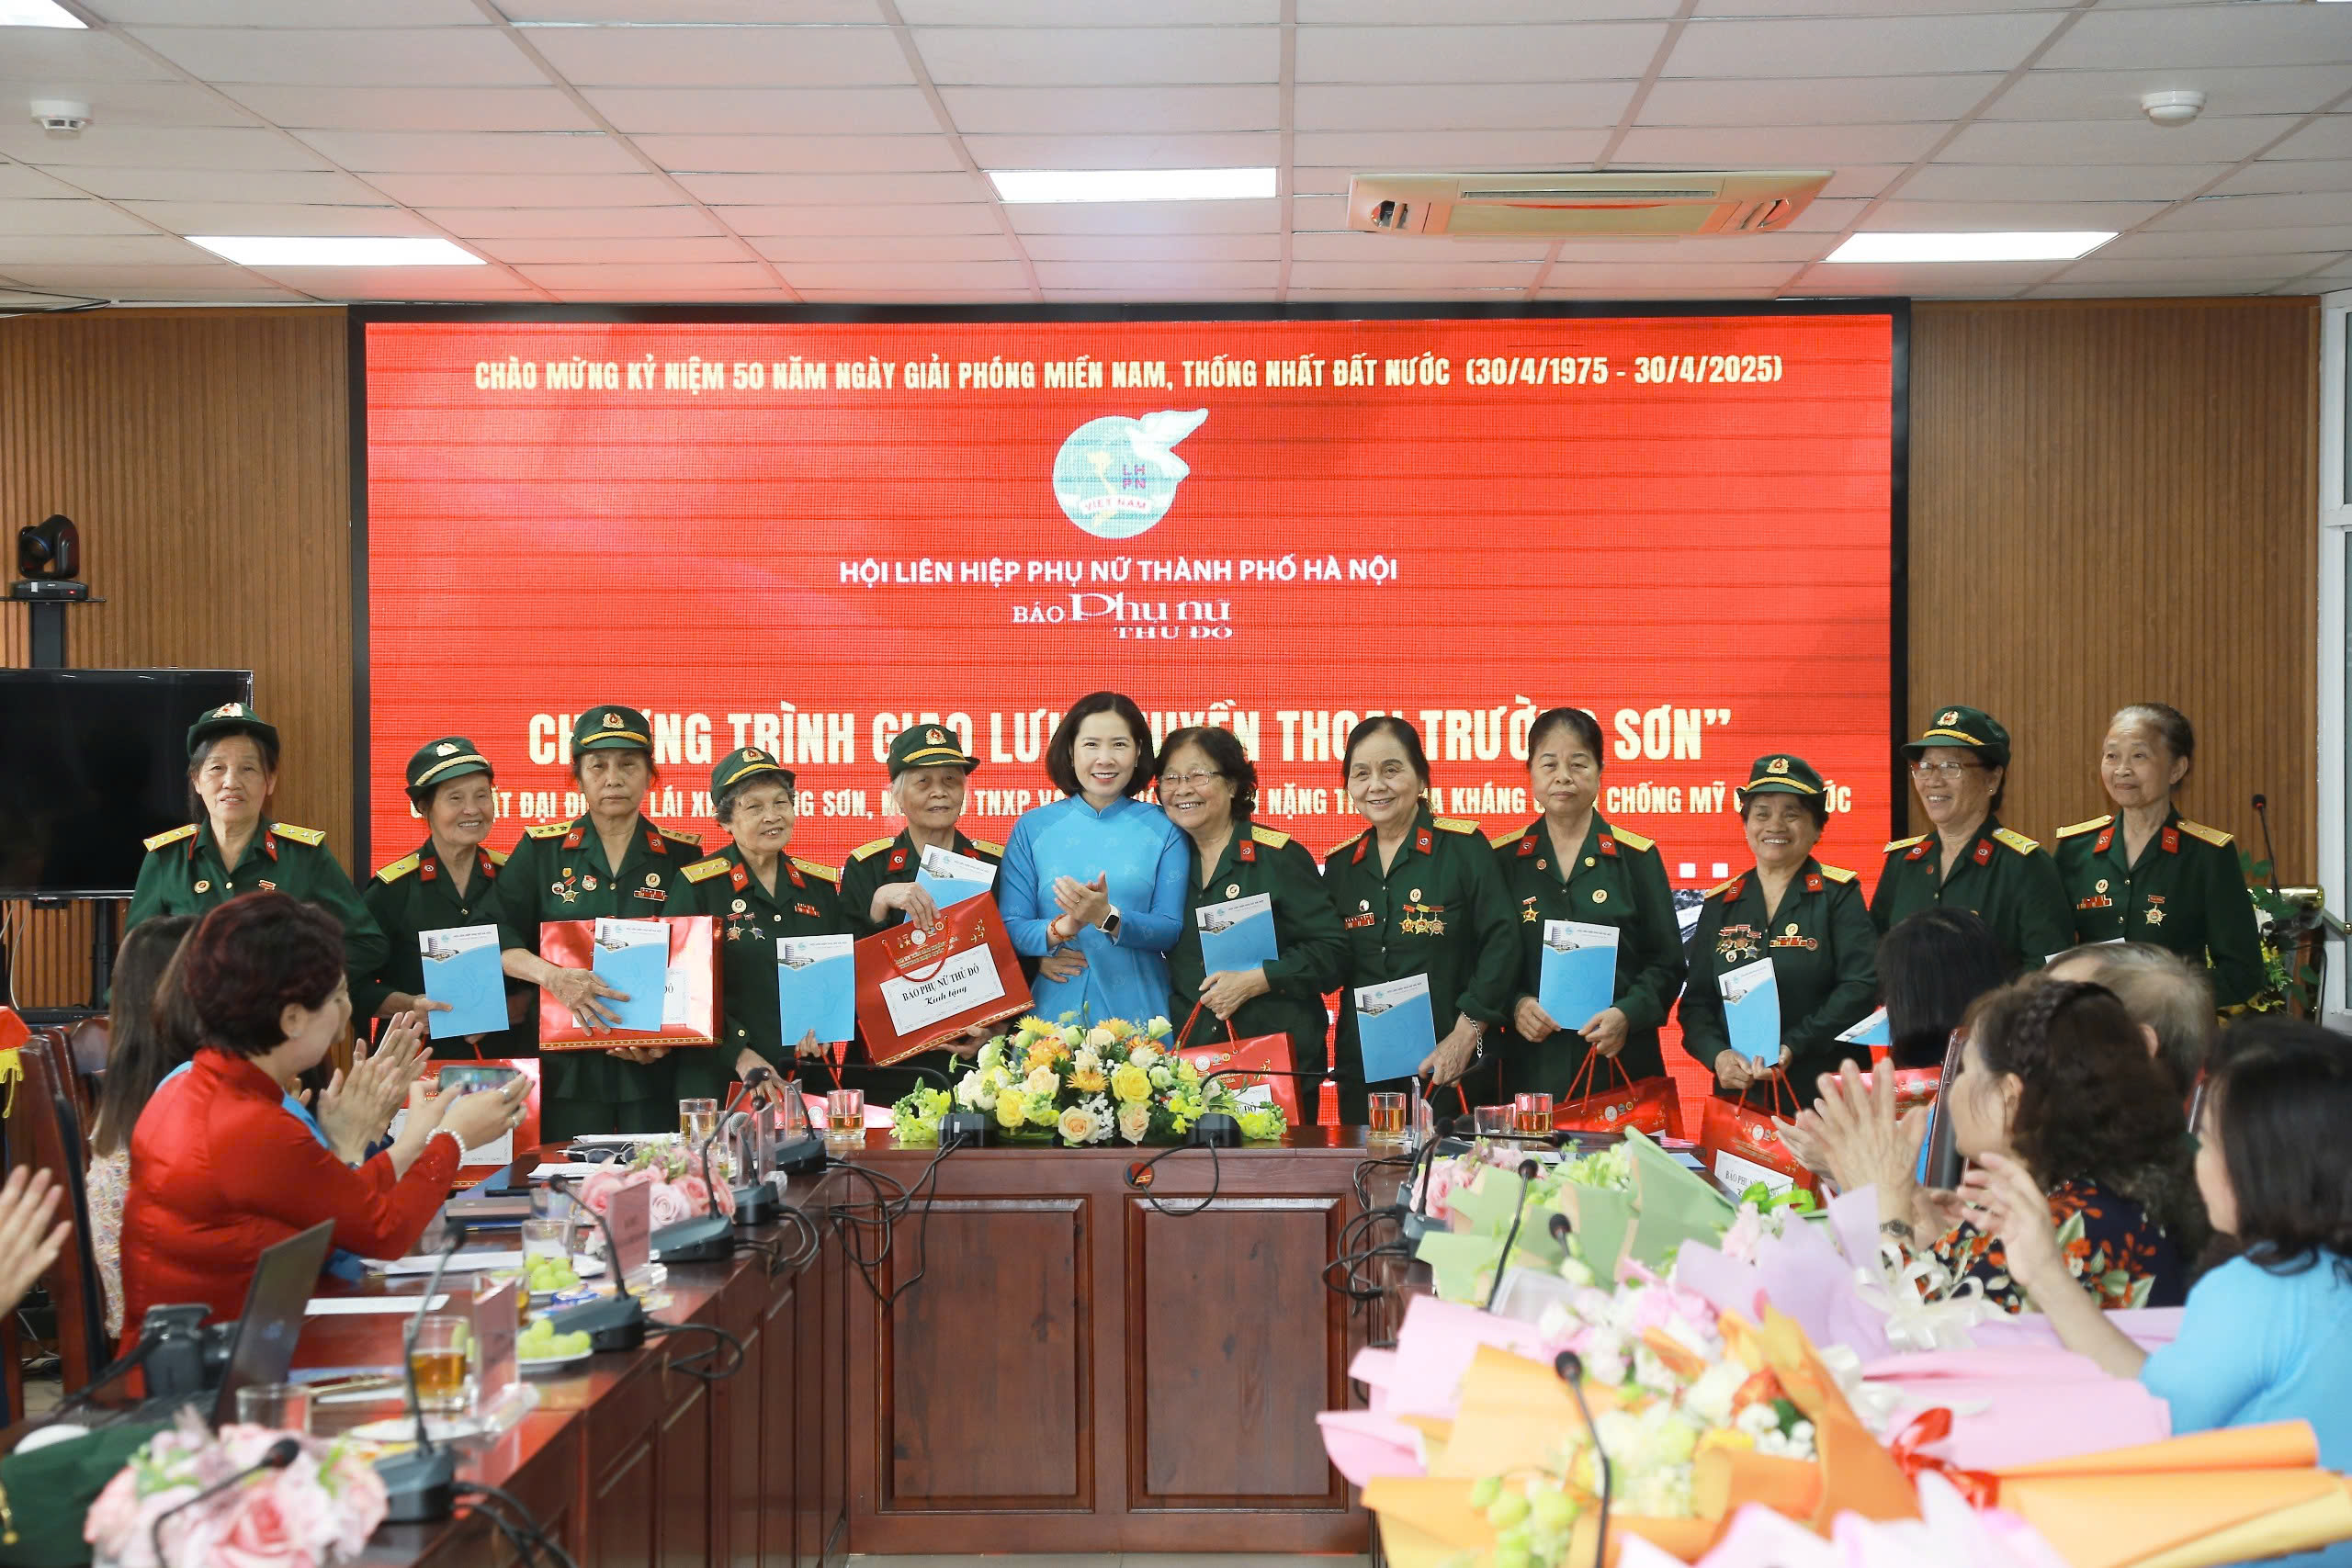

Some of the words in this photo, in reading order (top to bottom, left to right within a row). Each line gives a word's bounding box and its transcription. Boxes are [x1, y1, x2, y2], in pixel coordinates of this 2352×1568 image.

[475, 356, 537, 389] CHÀO
[547, 355, 618, 389] MỪNG
[628, 354, 656, 389] KỶ
[665, 356, 724, 395] NIỆM
[734, 362, 764, 389] 50
[773, 355, 826, 389] NĂM
[836, 356, 895, 389] NGÀY
[904, 353, 950, 389] GIẢI
[959, 355, 1035, 389] PHÓNG
[1111, 361, 1173, 390] NAM,
[1182, 354, 1257, 387] THỐNG
[1265, 354, 1325, 387] NHẤT
[1332, 353, 1378, 386] ĐẤT
[1385, 351, 1450, 386] NƯỚC
[1465, 357, 1609, 385] (30/4/1975
[1634, 355, 1783, 383] 30/4/2025)
[840, 558, 888, 588] HỘI
[895, 558, 953, 582] LIÊN
[960, 557, 1021, 588] HIỆP
[1027, 560, 1083, 587] PHỤ
[1091, 556, 1132, 581] NỮ
[1137, 557, 1232, 581] THÀNH
[1240, 553, 1297, 581] PHỐ
[1304, 555, 1342, 581] HÀ
[1349, 555, 1396, 586] NỘI
[1012, 601, 1065, 623] BÁO
[728, 700, 855, 764] TRÌNH
[872, 712, 973, 763] GO
[1276, 709, 1403, 761] THO
[1419, 694, 1597, 761] TRƯỜ
[519, 792, 556, 823] ĐẠI
[650, 784, 684, 818] LÁI
[822, 788, 874, 819] SƠN,
[974, 789, 1030, 817] TNXP
[1268, 783, 1328, 819] NẶNG
[1452, 782, 1526, 814] KHÁNG
[1607, 780, 1682, 814] CHỐNG
[1690, 780, 1726, 814] MỸ
[901, 987, 920, 1001] BÁO
[920, 981, 937, 995] PHỤ
[937, 975, 950, 988] NỮ
[949, 967, 967, 983] THỦ
[967, 963, 980, 976] ĐÔ
